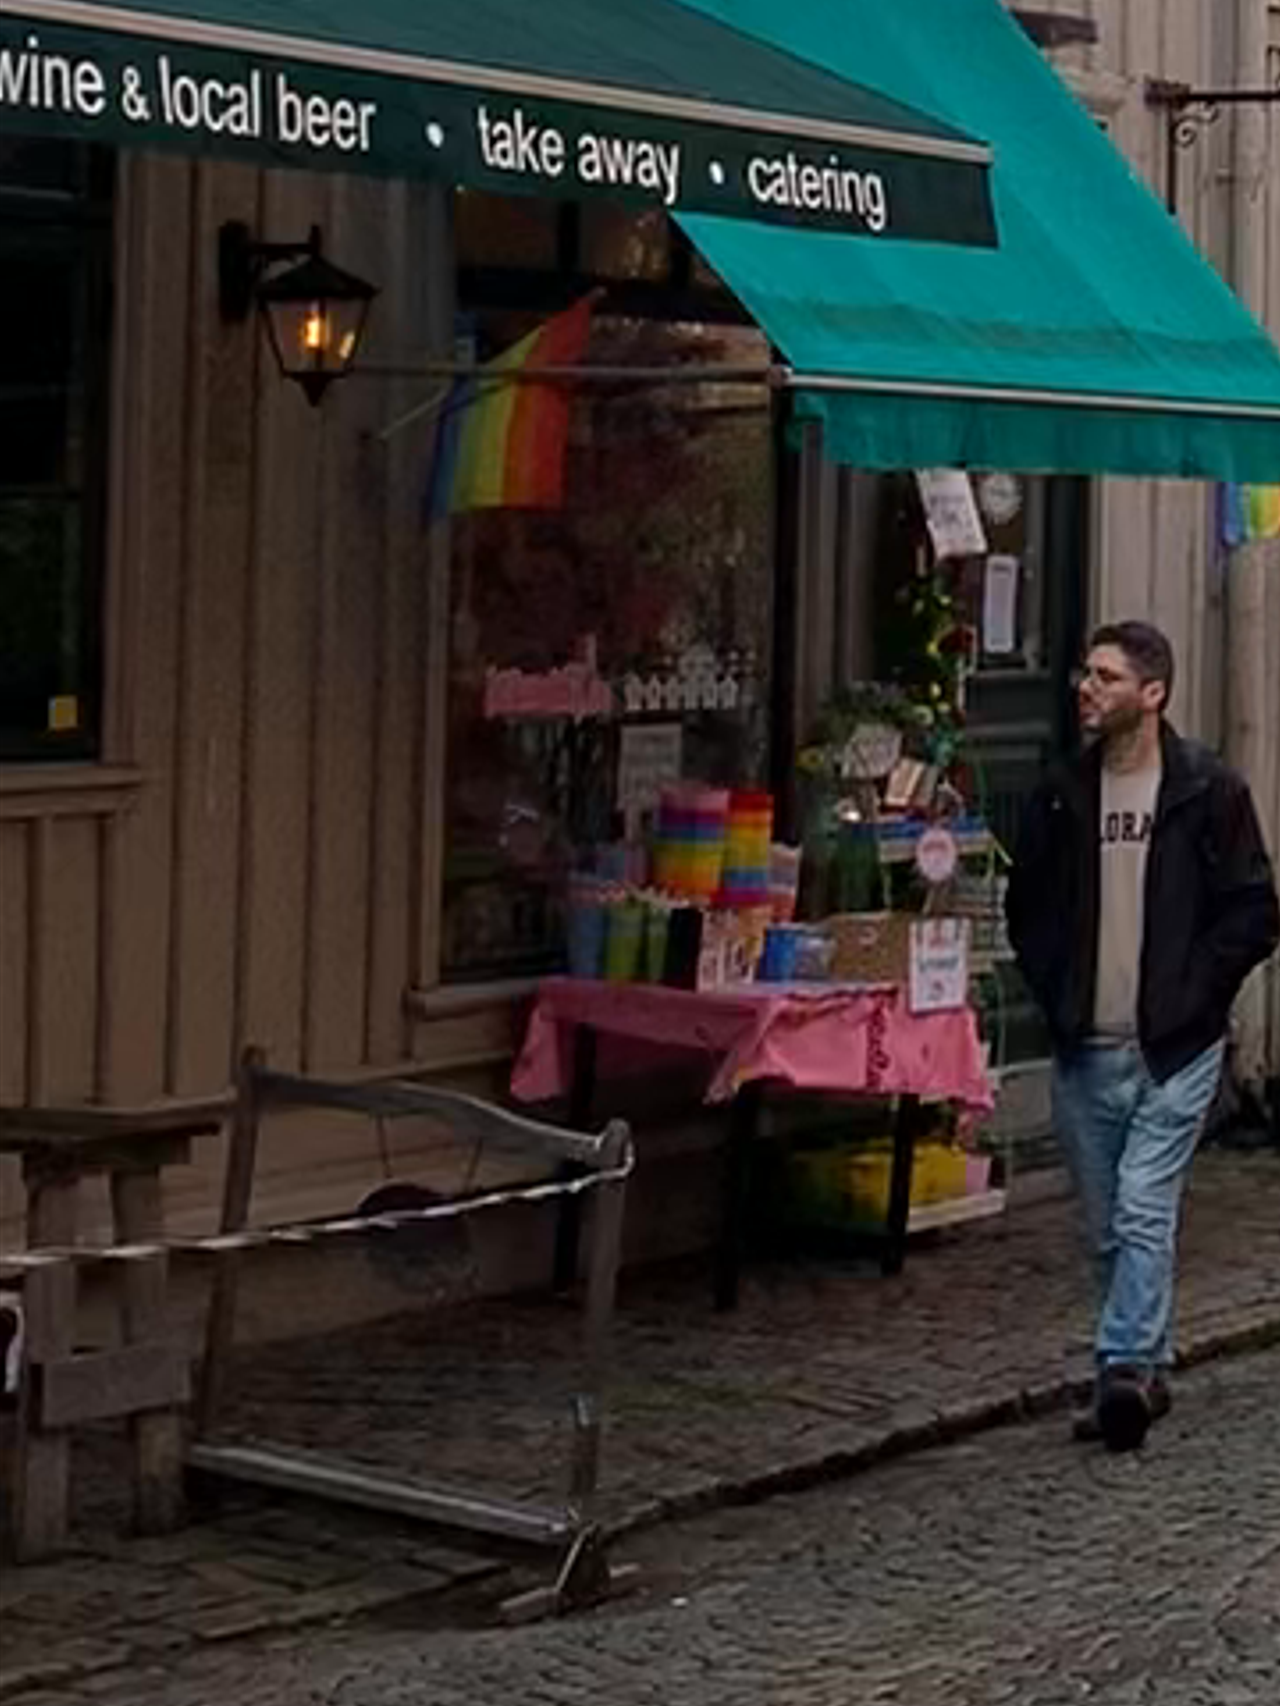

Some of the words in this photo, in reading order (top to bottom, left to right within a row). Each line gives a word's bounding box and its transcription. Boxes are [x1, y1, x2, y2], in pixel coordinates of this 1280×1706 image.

[121, 66, 151, 120] &
[159, 55, 261, 137] local
[278, 73, 377, 152] beer
[478, 105, 564, 177] take
[577, 131, 680, 204] away
[748, 153, 887, 231] catering
